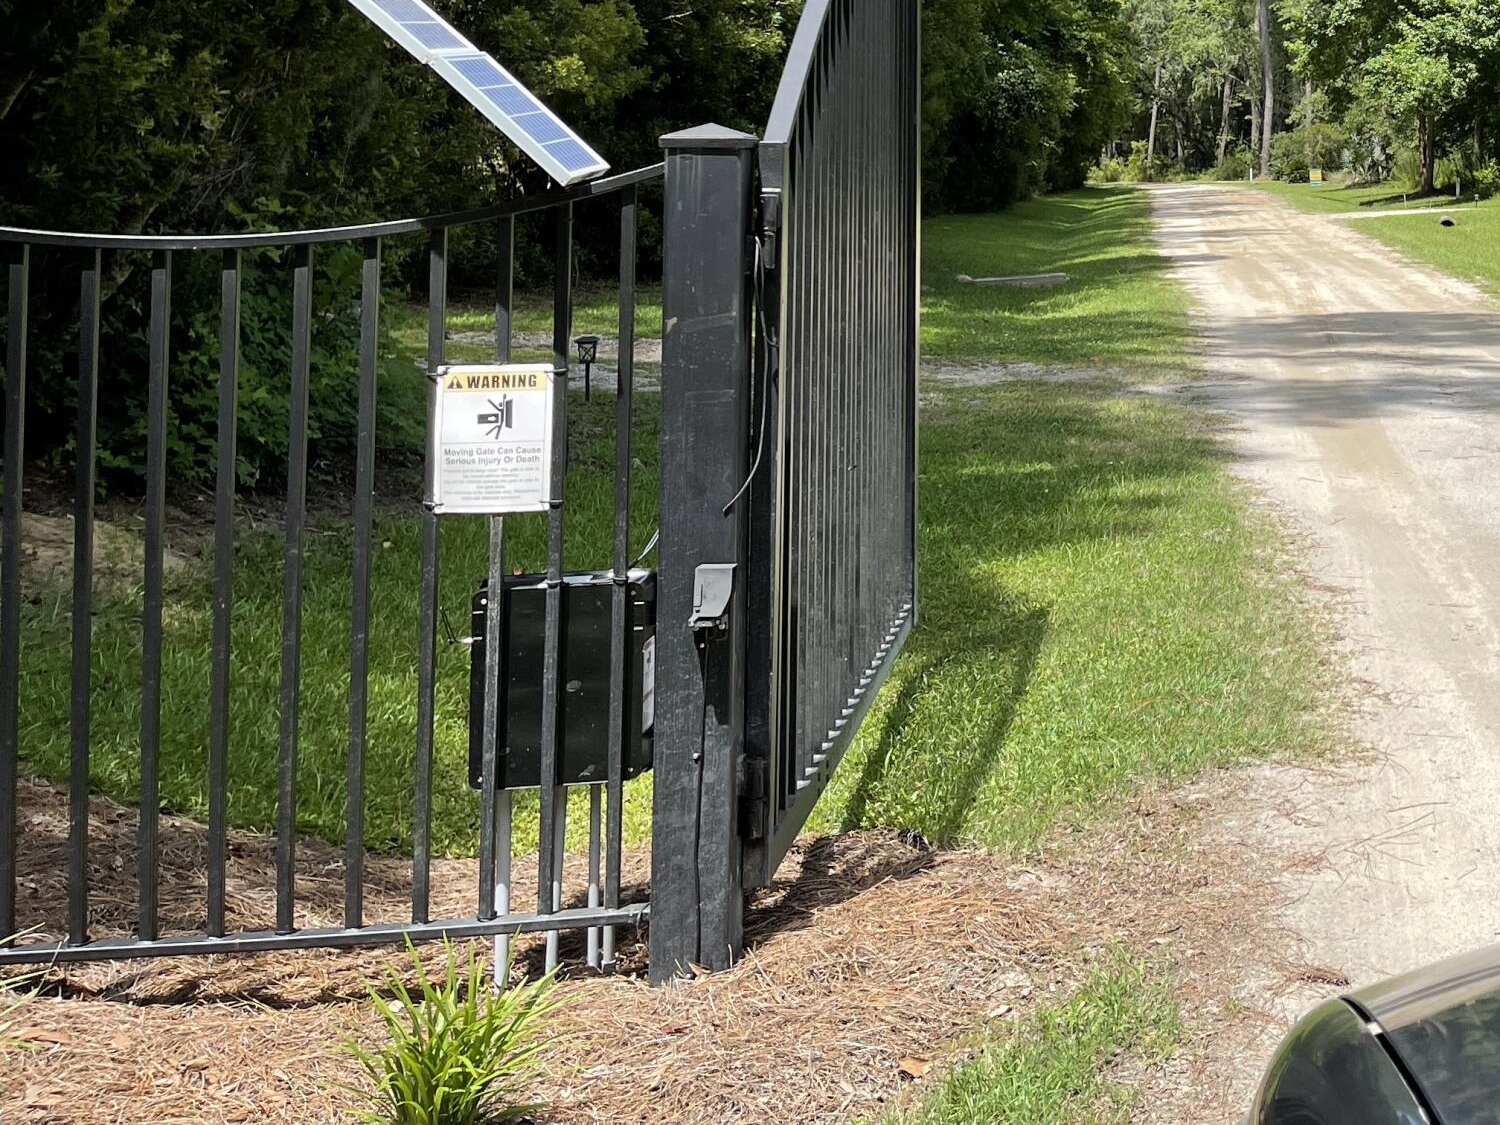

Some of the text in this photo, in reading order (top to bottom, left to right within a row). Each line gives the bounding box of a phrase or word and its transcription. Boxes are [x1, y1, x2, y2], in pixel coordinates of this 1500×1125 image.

[467, 374, 537, 389] WARNING
[444, 446, 541, 457] Moving Gate Can Cause
[445, 457, 476, 465] Serious
[478, 456, 501, 466] Injury
[516, 455, 540, 463] Death
